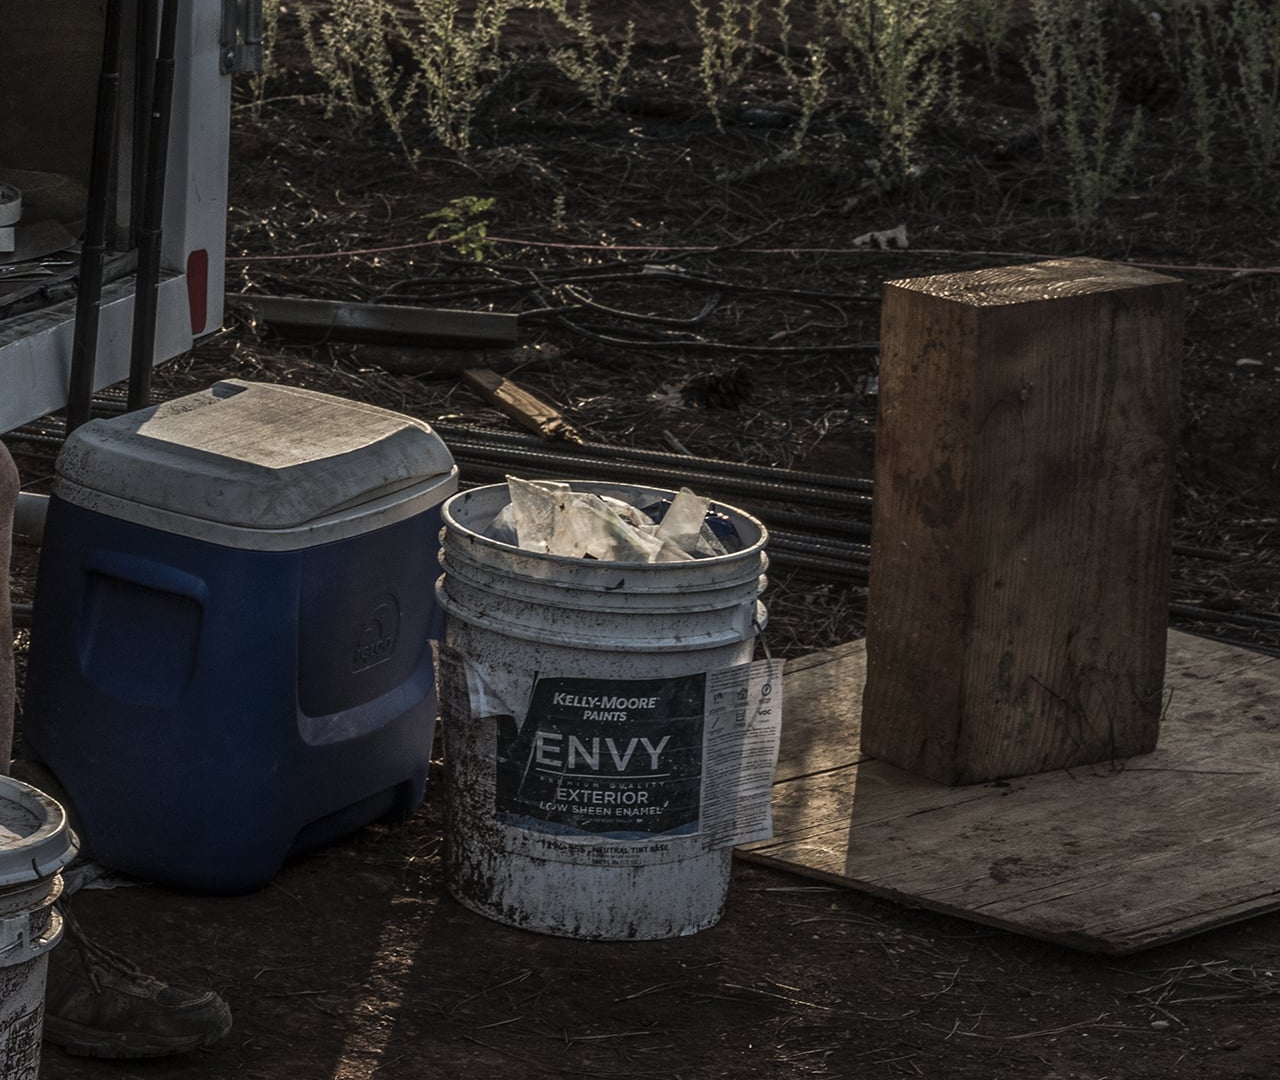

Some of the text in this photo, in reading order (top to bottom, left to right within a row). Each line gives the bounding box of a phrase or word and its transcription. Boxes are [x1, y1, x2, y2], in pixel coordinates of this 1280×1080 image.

[553, 692, 657, 710] KELLY-MOORE
[583, 710, 627, 721] PAINTS
[536, 730, 672, 771] ENVY
[557, 788, 649, 805] EXTERIOR
[539, 801, 662, 816] LOW SHEEN ENAMEL
